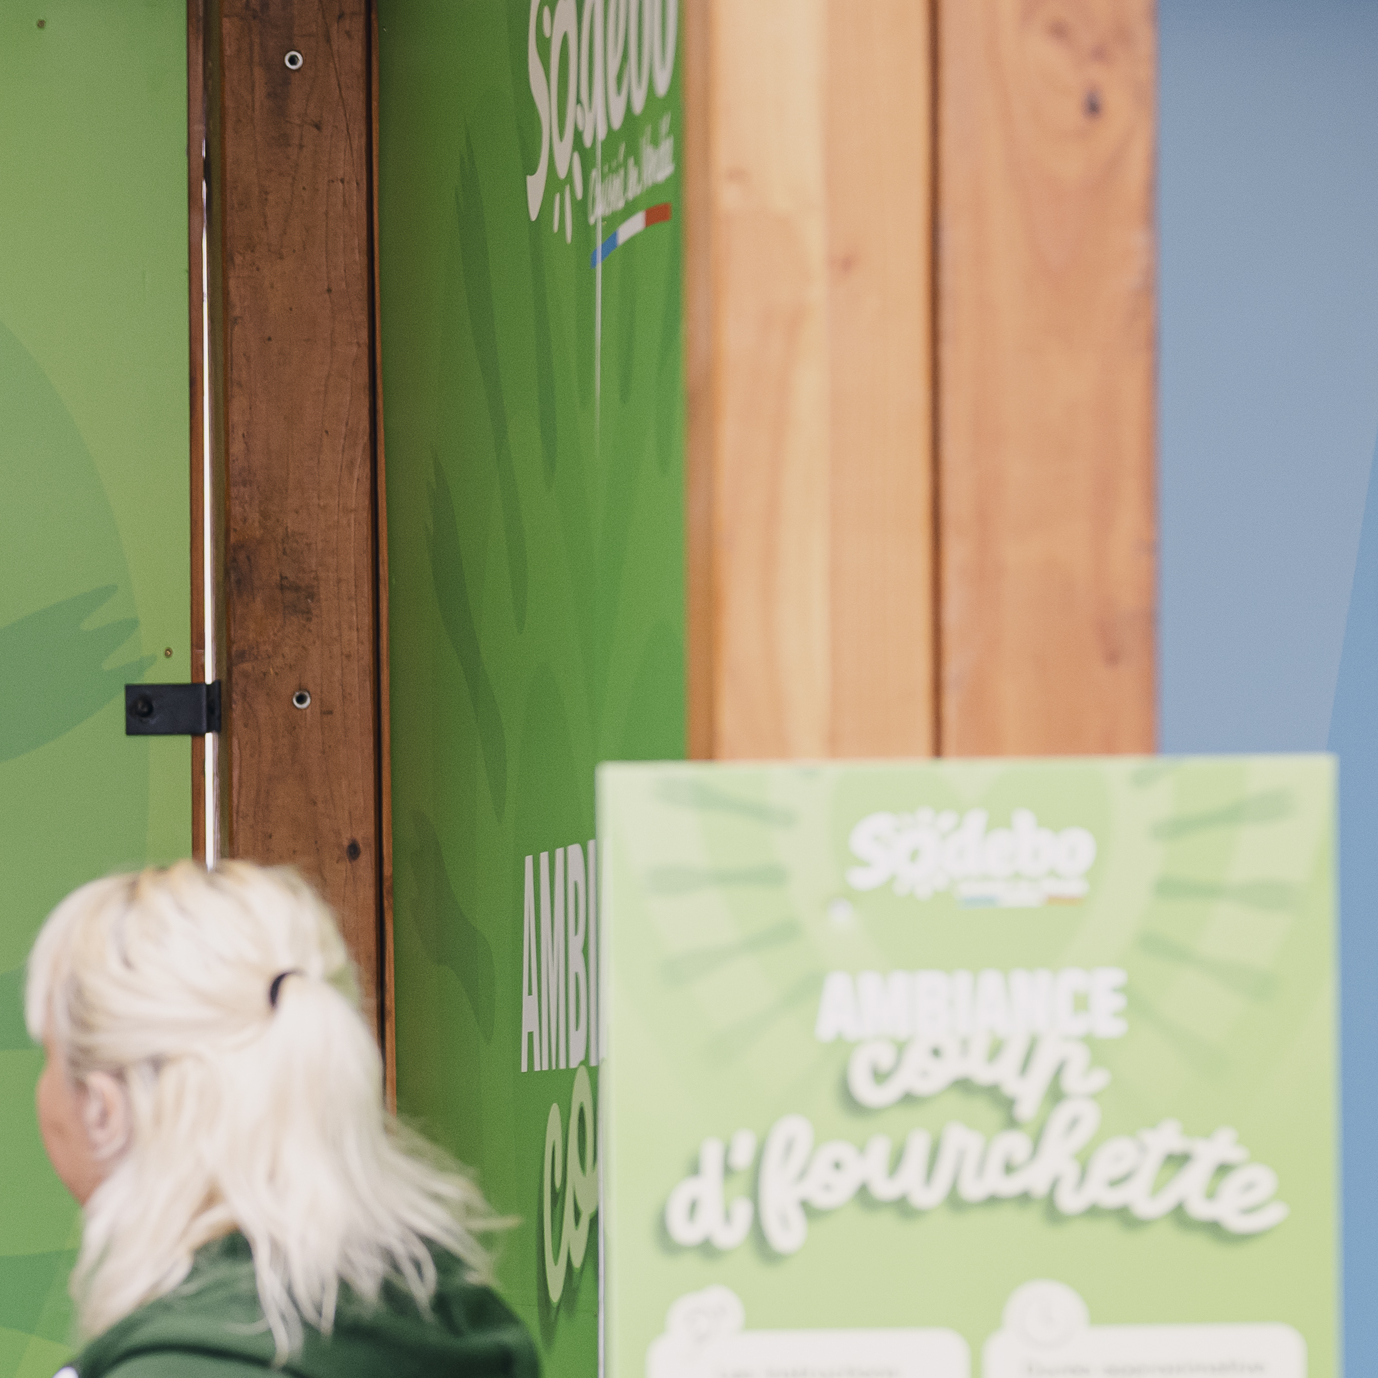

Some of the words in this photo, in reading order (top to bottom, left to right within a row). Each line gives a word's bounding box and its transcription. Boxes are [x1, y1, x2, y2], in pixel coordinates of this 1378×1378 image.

[521, 839, 599, 1073] AMBI
[815, 968, 1128, 1042] AMBIANCE
[847, 1033, 1111, 1121] coup
[544, 1065, 599, 1303] co
